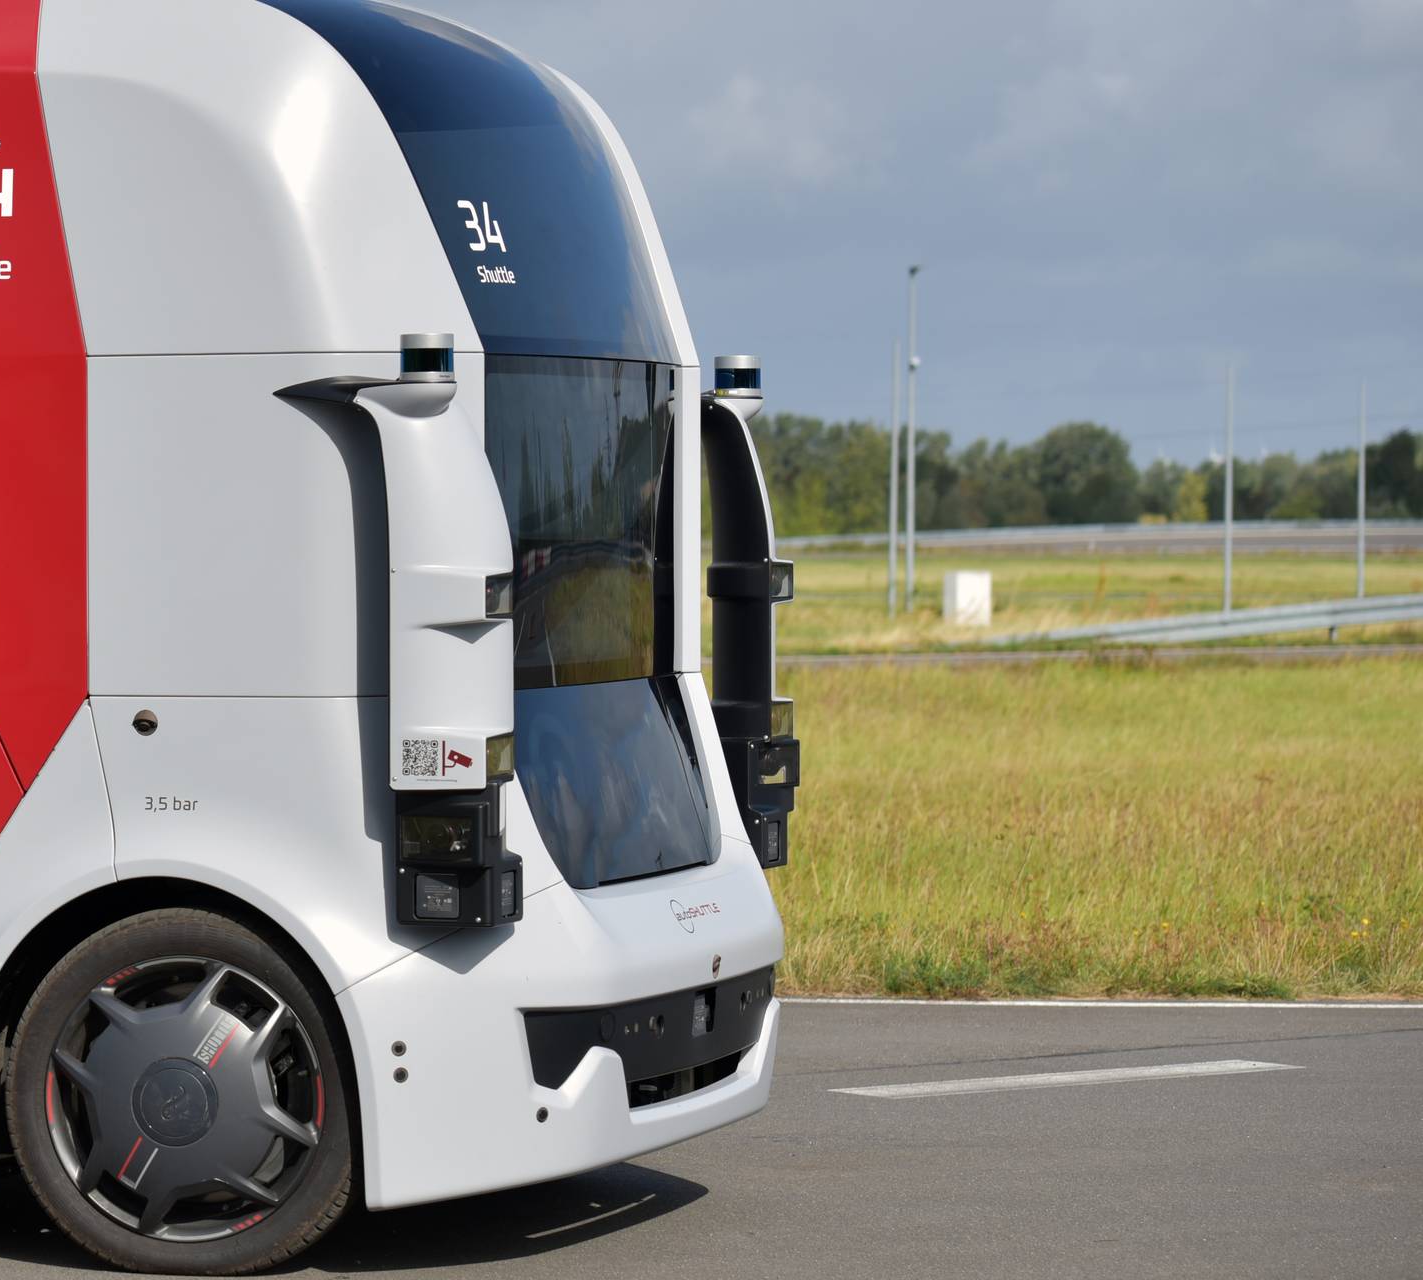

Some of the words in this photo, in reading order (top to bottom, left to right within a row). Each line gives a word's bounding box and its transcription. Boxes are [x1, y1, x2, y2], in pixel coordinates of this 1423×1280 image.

[457, 200, 507, 252] 34
[477, 265, 516, 284] Shuttle
[144, 796, 168, 813] 3,5
[172, 795, 199, 811] bar
